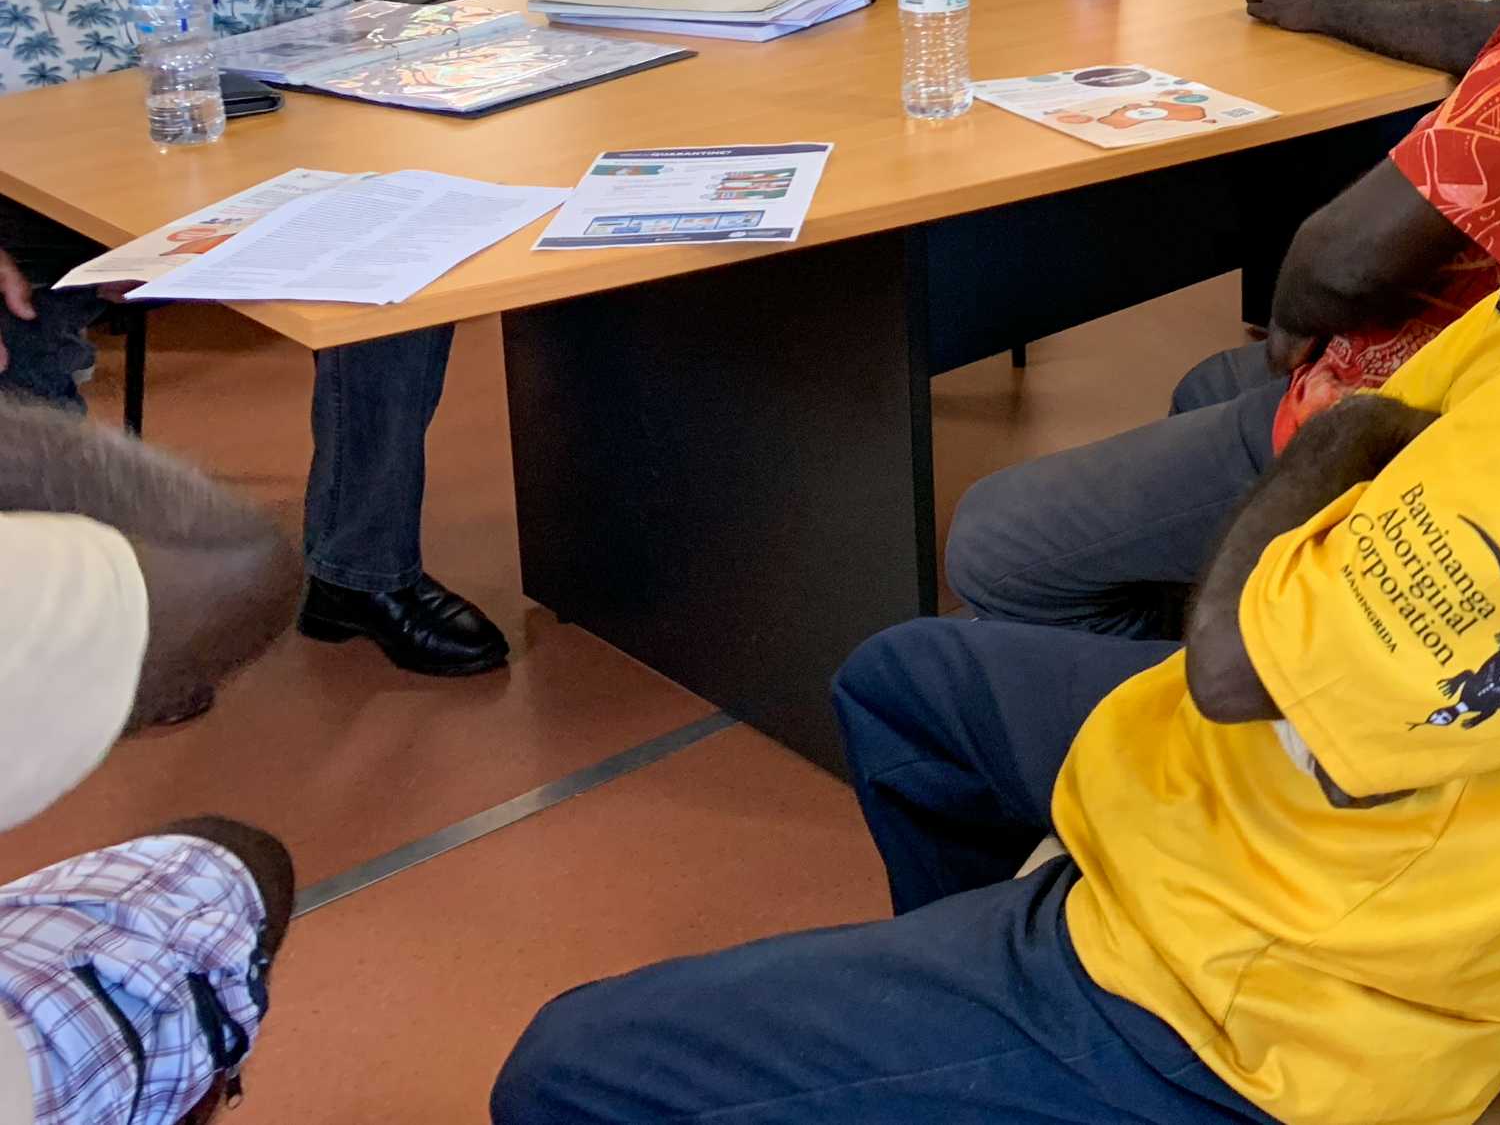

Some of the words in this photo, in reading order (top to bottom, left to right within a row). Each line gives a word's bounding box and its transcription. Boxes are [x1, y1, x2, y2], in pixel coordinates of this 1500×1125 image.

[1341, 563, 1398, 654] MANINGRIDA
[1349, 512, 1455, 667] Corporation
[1377, 508, 1478, 636] Aboriginal
[1401, 481, 1496, 619] Bawinanga
